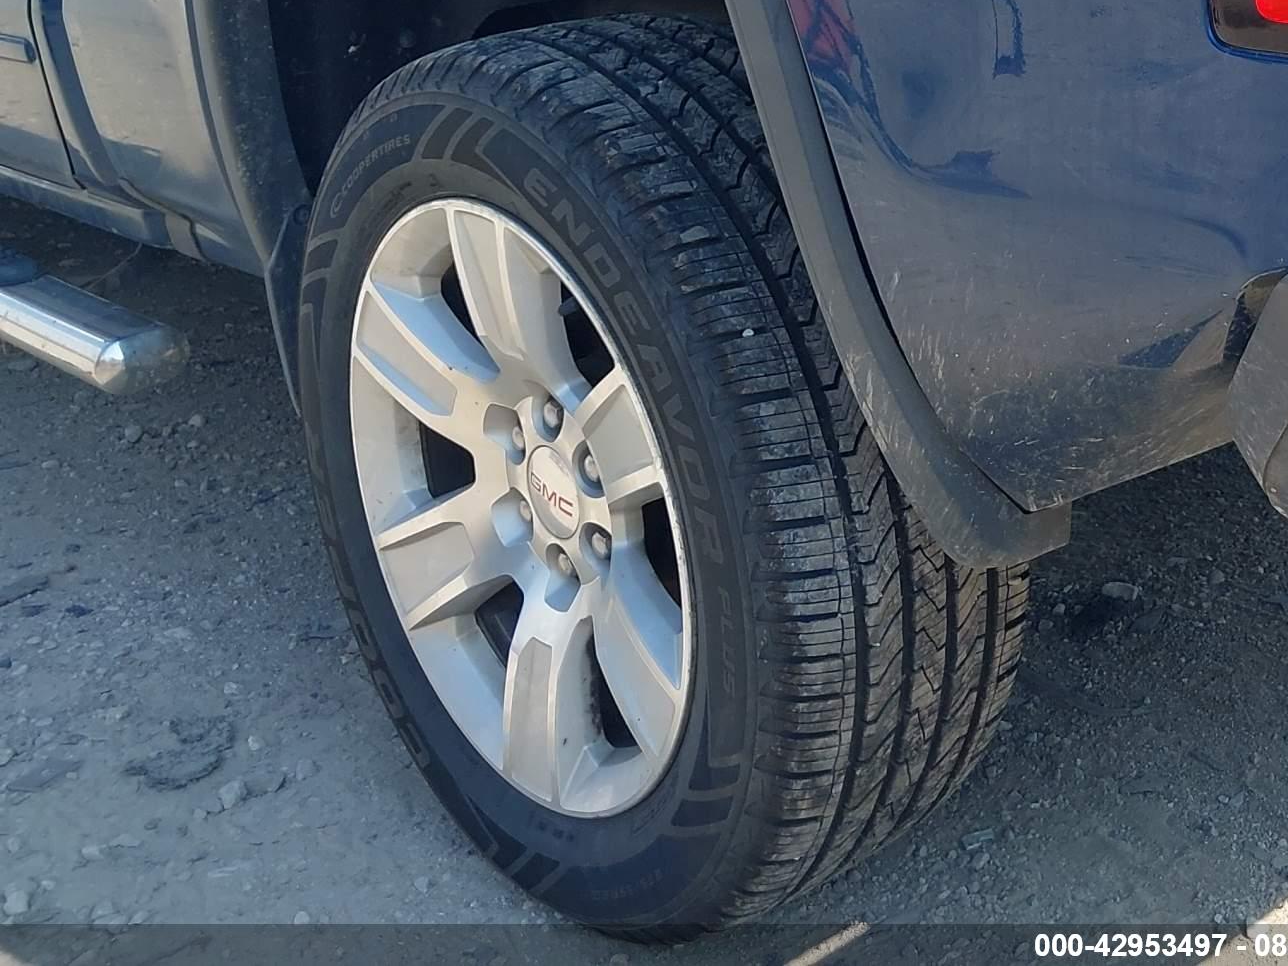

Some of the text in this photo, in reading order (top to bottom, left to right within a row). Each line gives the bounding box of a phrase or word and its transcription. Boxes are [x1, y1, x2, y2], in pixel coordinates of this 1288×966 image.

[522, 166, 736, 699] ENDEAVOR PLUS
[530, 471, 574, 518] GMC
